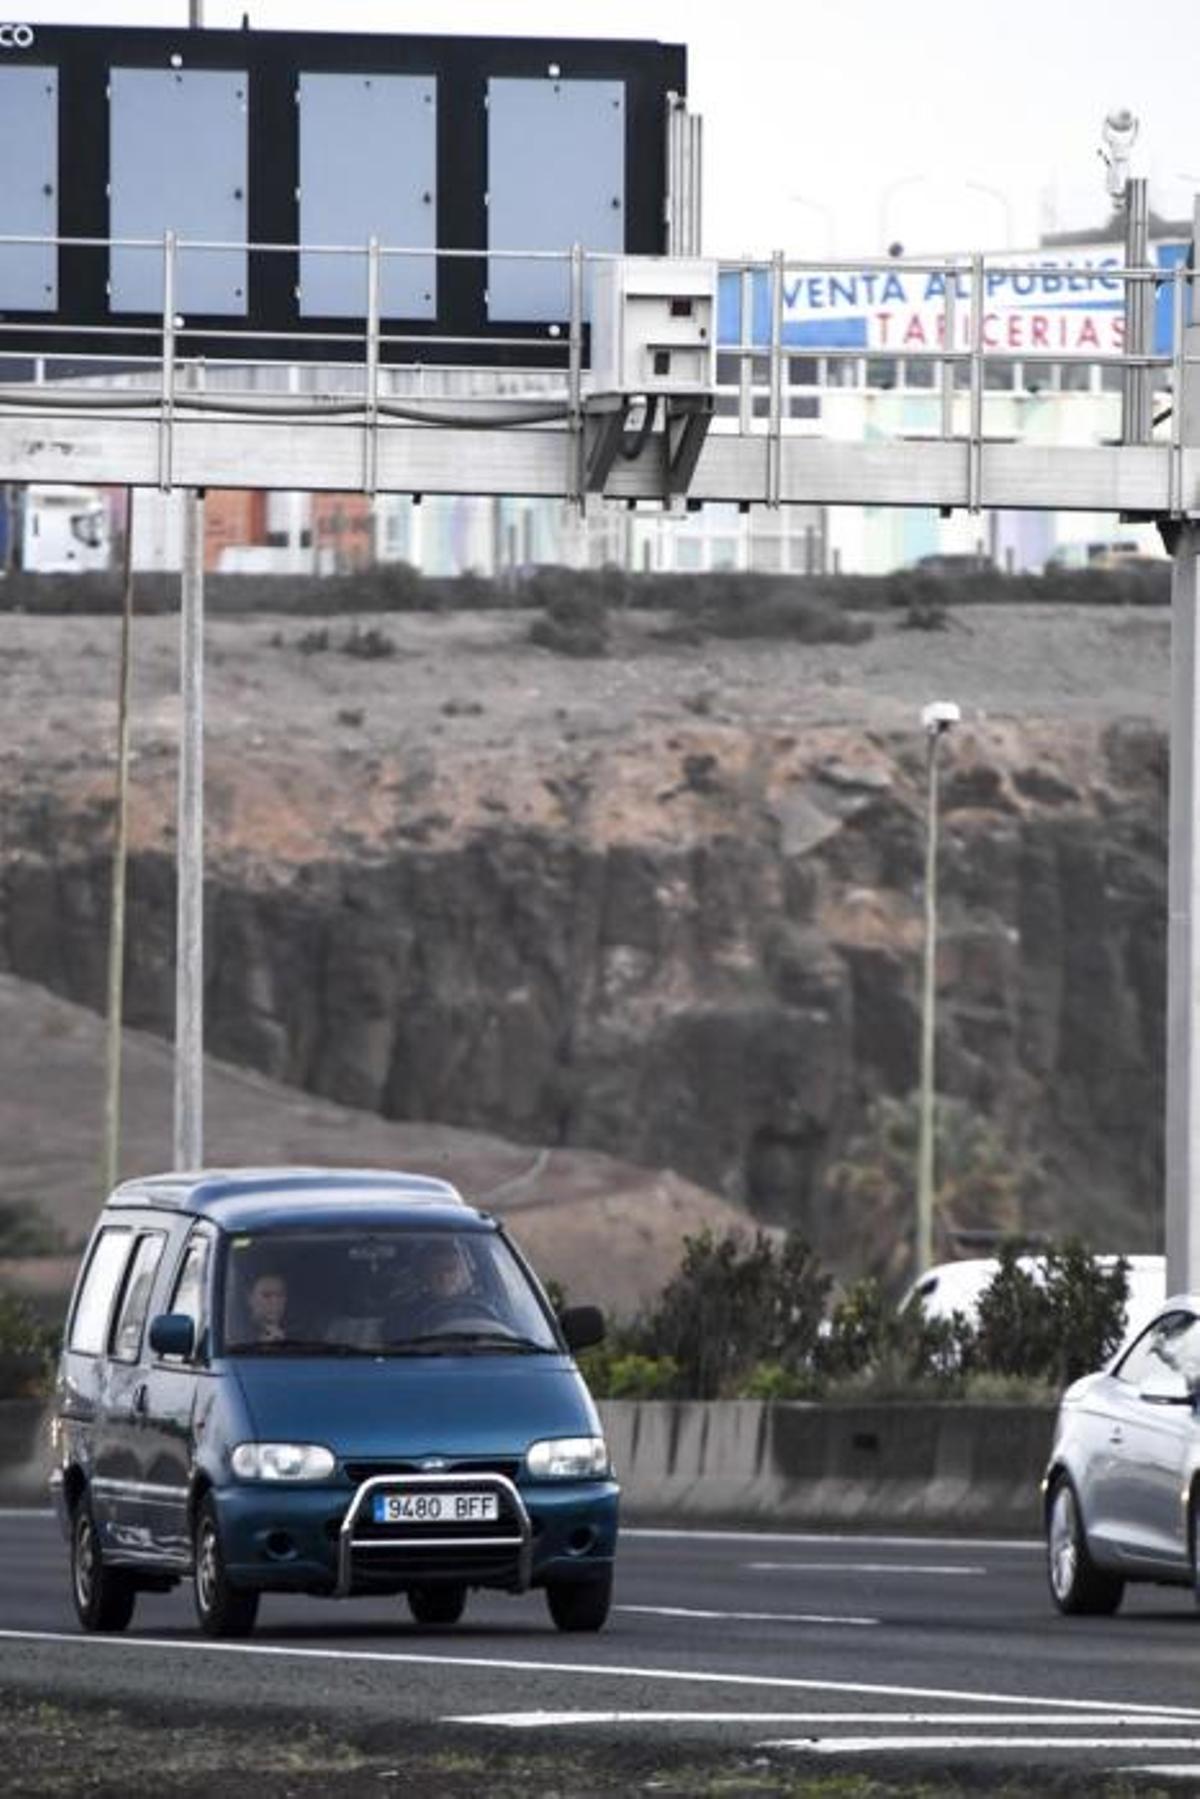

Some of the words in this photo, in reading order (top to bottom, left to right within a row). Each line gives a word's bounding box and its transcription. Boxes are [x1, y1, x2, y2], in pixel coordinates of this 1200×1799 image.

[782, 271, 907, 308] VENTA
[924, 268, 969, 300] AL
[985, 258, 1121, 297] PUBLIC
[388, 1496, 442, 1519] 9480
[455, 1496, 494, 1518] BFF
